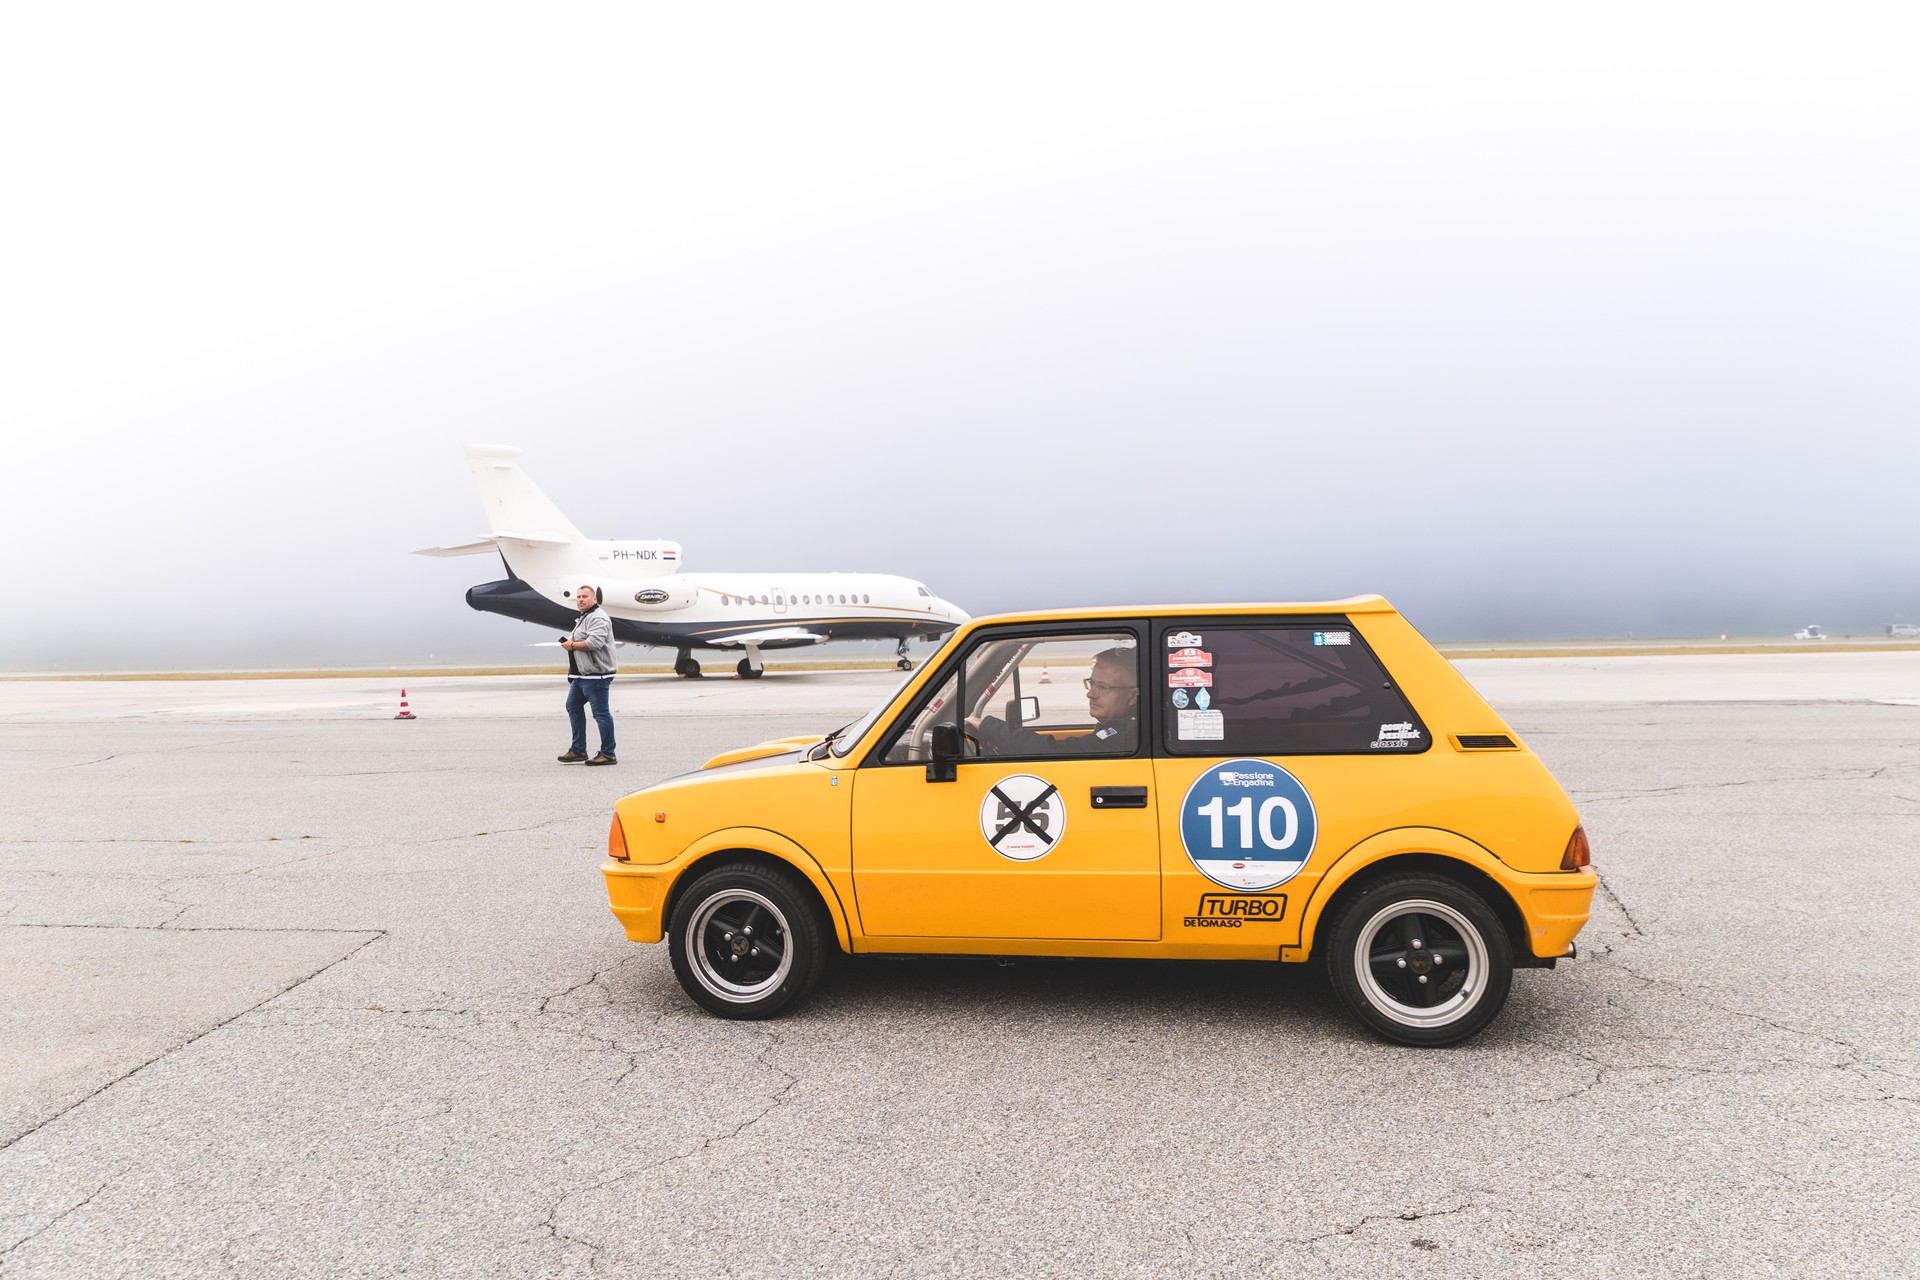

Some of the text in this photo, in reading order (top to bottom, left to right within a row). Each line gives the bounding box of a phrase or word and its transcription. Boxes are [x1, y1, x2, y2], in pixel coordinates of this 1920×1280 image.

[613, 550, 657, 560] PH-NDK
[1370, 738, 1408, 748] classic
[1233, 772, 1274, 780] Passione
[1233, 779, 1274, 787] Engadina
[1198, 796, 1299, 850] 110
[1206, 899, 1279, 916] TURBO
